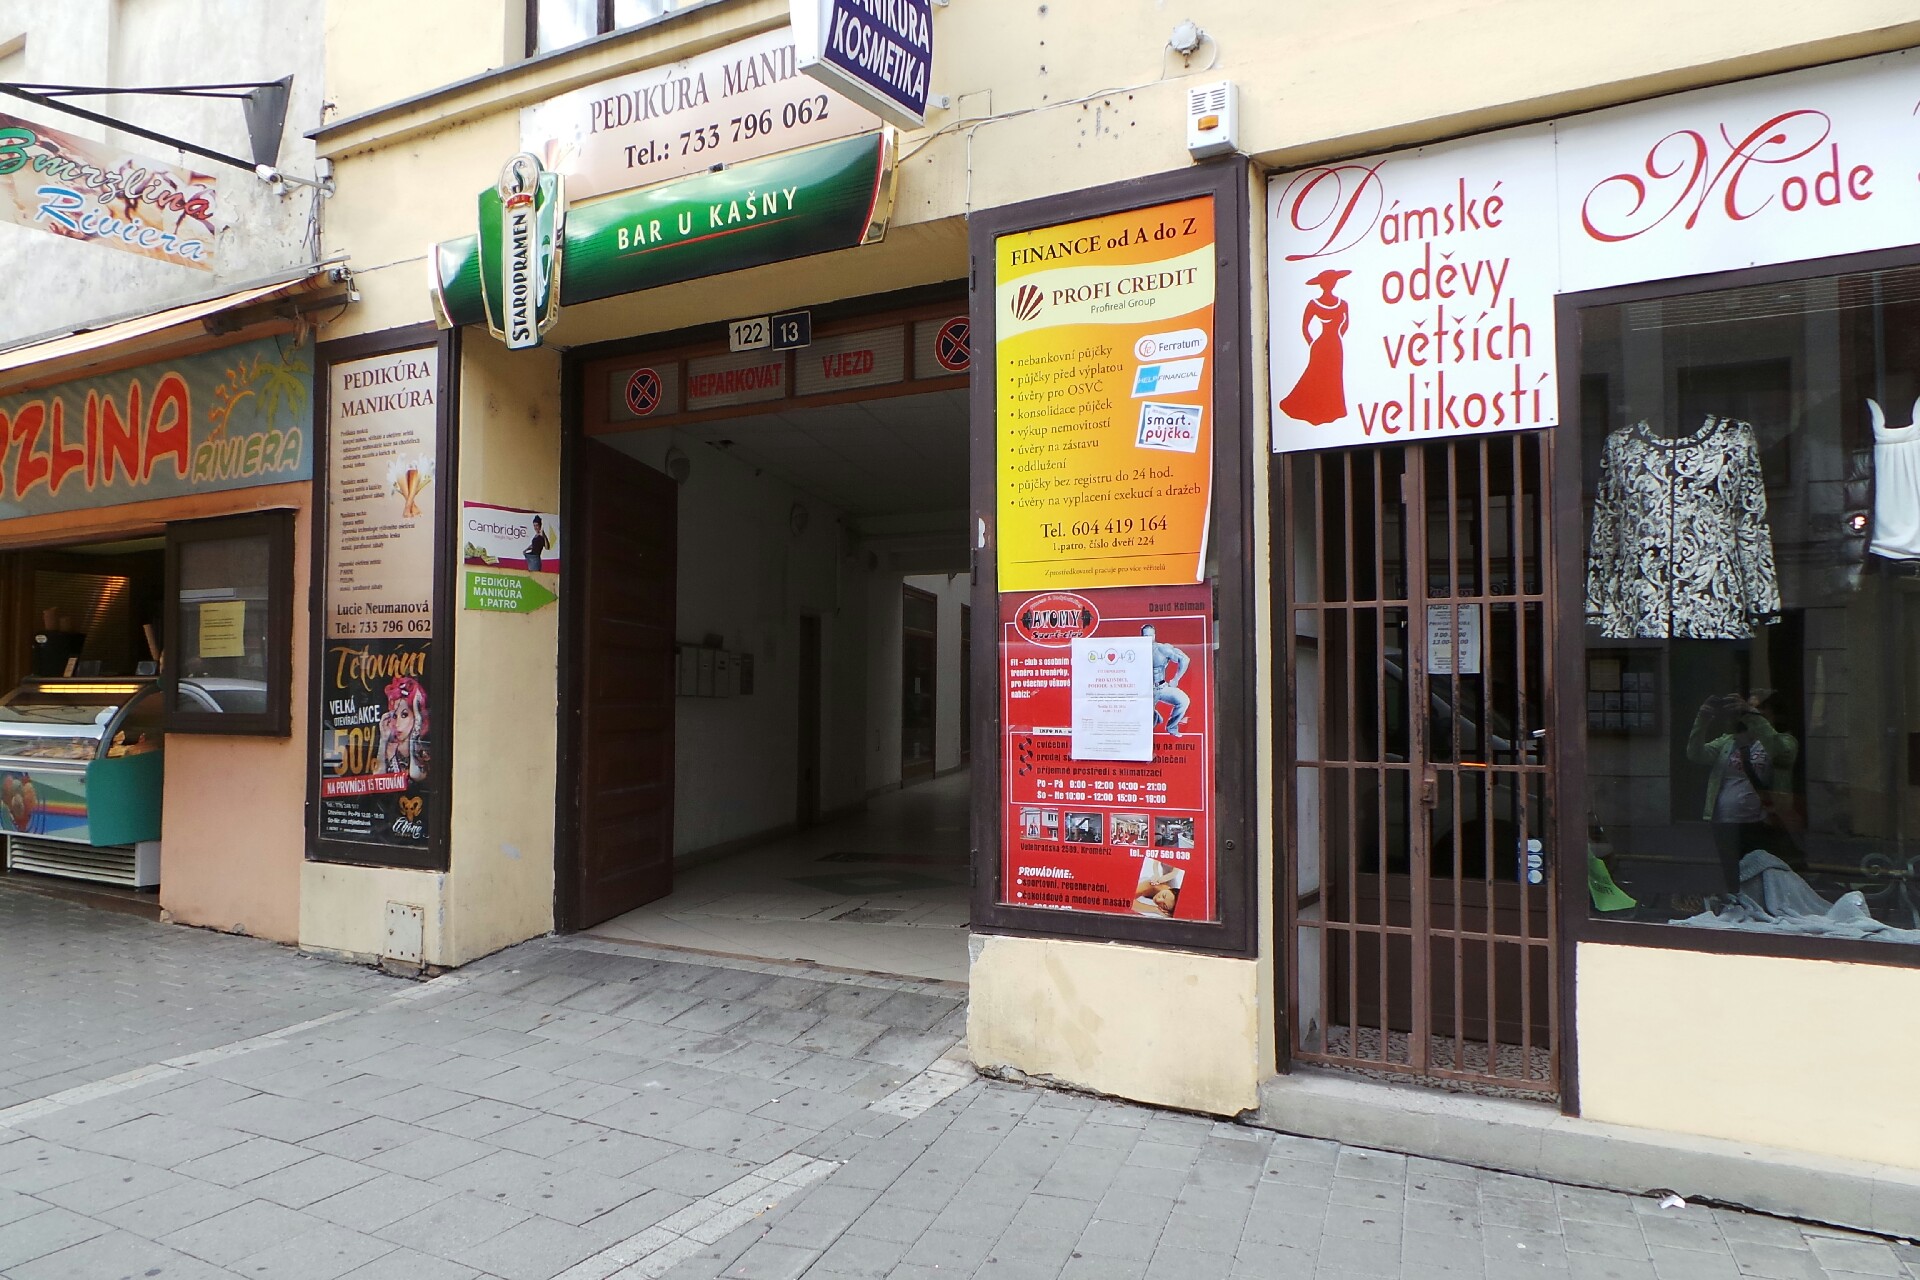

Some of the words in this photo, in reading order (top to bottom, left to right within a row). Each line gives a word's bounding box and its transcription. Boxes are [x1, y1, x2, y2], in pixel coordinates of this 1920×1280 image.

[832, 6, 925, 104] KOSMETIKA
[589, 69, 711, 135] PEDIKÚRA
[623, 140, 670, 169] Tel.:
[680, 123, 721, 156] 733
[730, 108, 774, 143] 796
[782, 93, 830, 129] 062
[1581, 109, 1874, 243] Mode
[34, 186, 208, 259] Riviera
[617, 218, 663, 250] BAR
[678, 211, 692, 236] U
[708, 186, 798, 228] KAŠNY
[1276, 159, 1504, 262] Dámské
[1010, 234, 1102, 267] FINANCE
[1106, 228, 1130, 249] od
[1133, 226, 1149, 245] A
[1153, 222, 1177, 241] do
[1182, 216, 1198, 236] Z
[511, 213, 530, 342] STAROPRAMEN
[1052, 281, 1111, 306] PROFI
[1117, 267, 1198, 295] CREDIT
[1381, 242, 1510, 309] oděvy
[1090, 300, 1127, 314] Profireal
[1128, 297, 1156, 309] Group
[733, 322, 764, 346] 122
[780, 321, 800, 344] 13
[1382, 297, 1531, 370] větších
[1017, 350, 1076, 367] nebankovní
[1078, 345, 1113, 363] půjčky
[1158, 338, 1200, 353] Ferratum
[343, 359, 431, 391] PEDIKÚRA
[822, 350, 875, 379] VJEZD
[1017, 370, 1051, 387] půjčky
[1053, 366, 1076, 383] před
[1078, 363, 1124, 379] výplatou
[687, 362, 784, 399] NEPARKOVAT
[1017, 387, 1044, 404] úvěry
[1047, 388, 1065, 401] pro
[1067, 380, 1104, 396] OSVČ
[340, 387, 434, 419] MANIKÚRA
[1017, 403, 1076, 419] konsolidace
[1078, 398, 1113, 415] půjček
[1357, 363, 1550, 437] velikostí
[1017, 424, 1048, 440] výkup
[1050, 417, 1111, 434] nemovitostí
[1145, 425, 1190, 443] půjčka
[191, 427, 302, 485] RIVIERA
[1017, 441, 1044, 456] úvěry
[1047, 443, 1060, 452] na
[1062, 437, 1100, 450] zástavu
[1017, 458, 1067, 473] oddlužení
[1017, 477, 1051, 493] půjčky
[1053, 475, 1071, 487] bez
[1073, 472, 1113, 488] registru
[1115, 470, 1129, 482] do
[1132, 468, 1146, 481] 24
[1149, 466, 1174, 479] hod.
[1017, 495, 1045, 509] úvěry
[1047, 496, 1060, 506] na
[1063, 489, 1112, 509] vyplacení
[1113, 486, 1154, 501] exekucí
[1156, 489, 1163, 497] a
[1165, 482, 1201, 497] dražeb
[468, 519, 528, 540] Cambridge
[1040, 522, 1066, 539] Tel.
[1071, 520, 1100, 537] 604
[1104, 518, 1133, 534] 419
[1139, 514, 1168, 532] 164
[1088, 538, 1109, 550] číslo
[1111, 537, 1136, 548] dveří
[1137, 536, 1155, 547] 224
[473, 586, 523, 599] MANIKÚRA
[474, 575, 522, 589] PEDIKÚRA
[336, 602, 363, 616] Lucie
[365, 599, 430, 615] Neumanová
[479, 597, 518, 609] 1.PATRO
[1148, 602, 1171, 613] David
[335, 621, 357, 634] Tel.:
[359, 620, 379, 634] 733
[382, 619, 404, 633] 796
[407, 619, 432, 632] 062
[328, 641, 432, 692] Tetování
[1010, 679, 1022, 689] pro
[329, 693, 356, 715] VELKÁ
[358, 704, 381, 724] AKCE
[1163, 743, 1173, 751] na
[327, 782, 336, 795] NA
[336, 777, 366, 794] PRVNÍCH
[374, 771, 406, 791] TETOVÁNÍ
[1036, 779, 1047, 788] Po
[1054, 779, 1064, 789] Pá
[1094, 780, 1114, 790] 12:00
[1117, 781, 1139, 791] 14:00
[1146, 782, 1167, 791] 21:00
[1036, 791, 1047, 800] So
[1065, 791, 1086, 801] 10:00
[1093, 792, 1114, 801] 12:00
[1117, 793, 1138, 803] 15:00
[1065, 895, 1071, 903] a
